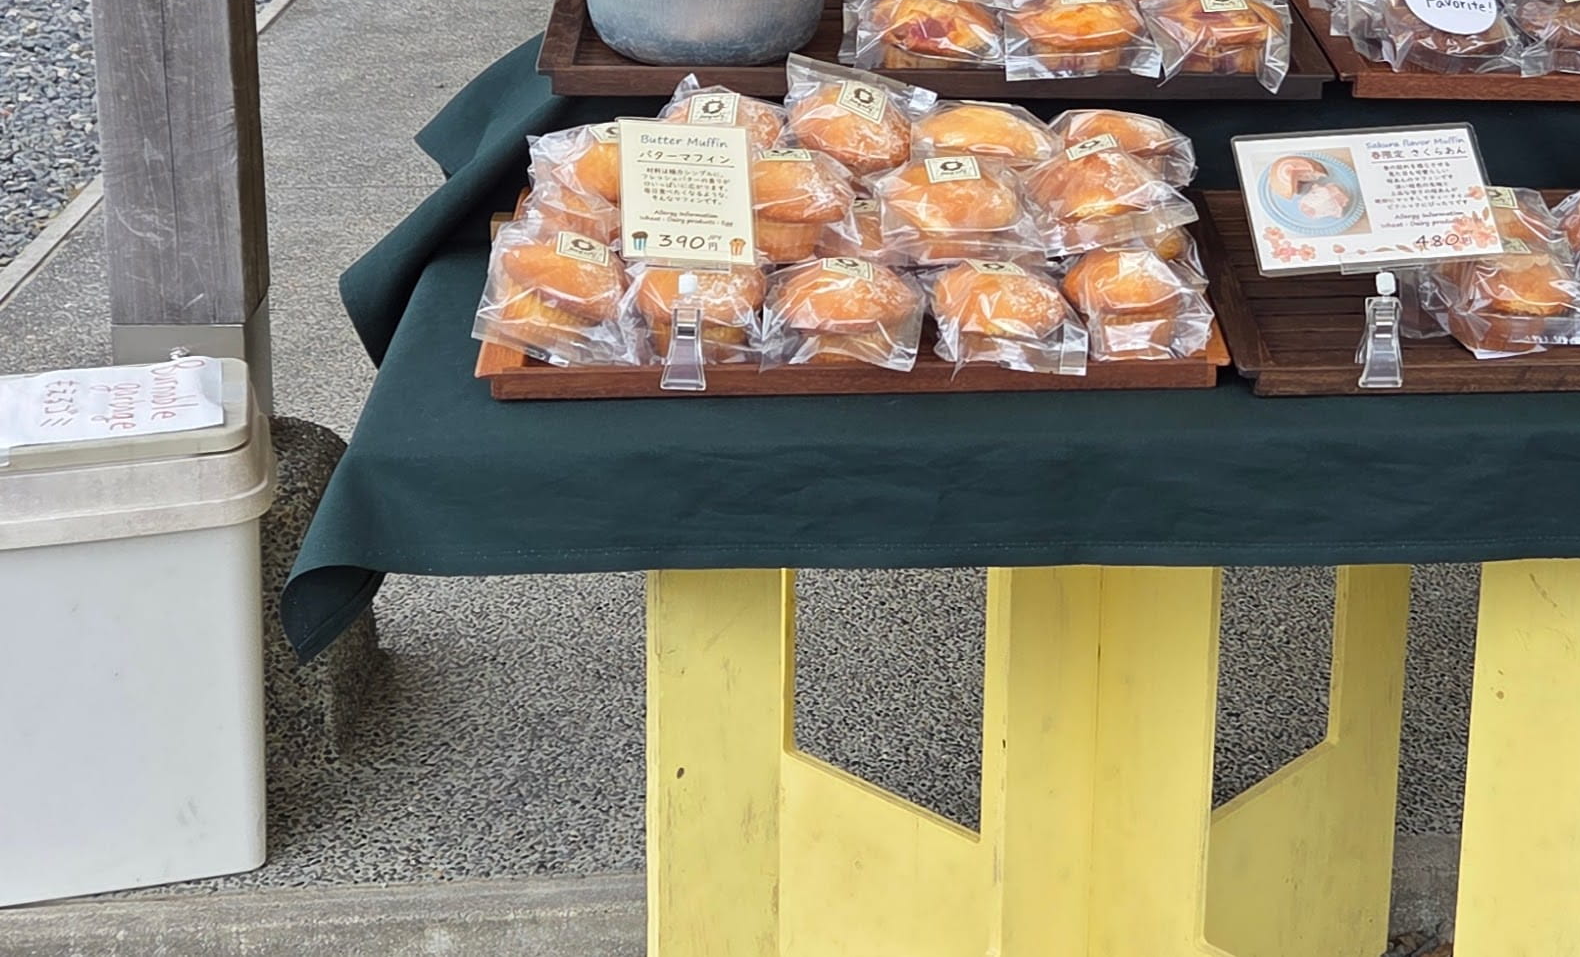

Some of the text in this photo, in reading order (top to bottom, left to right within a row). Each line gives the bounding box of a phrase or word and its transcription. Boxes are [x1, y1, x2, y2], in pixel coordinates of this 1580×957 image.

[640, 134, 728, 148] Butter Muffin
[639, 150, 731, 164] バターマフィン
[1371, 146, 1466, 159] 春限定 さくらあん
[658, 234, 706, 250] 390
[708, 241, 718, 251] 円
[1415, 234, 1460, 248] 480
